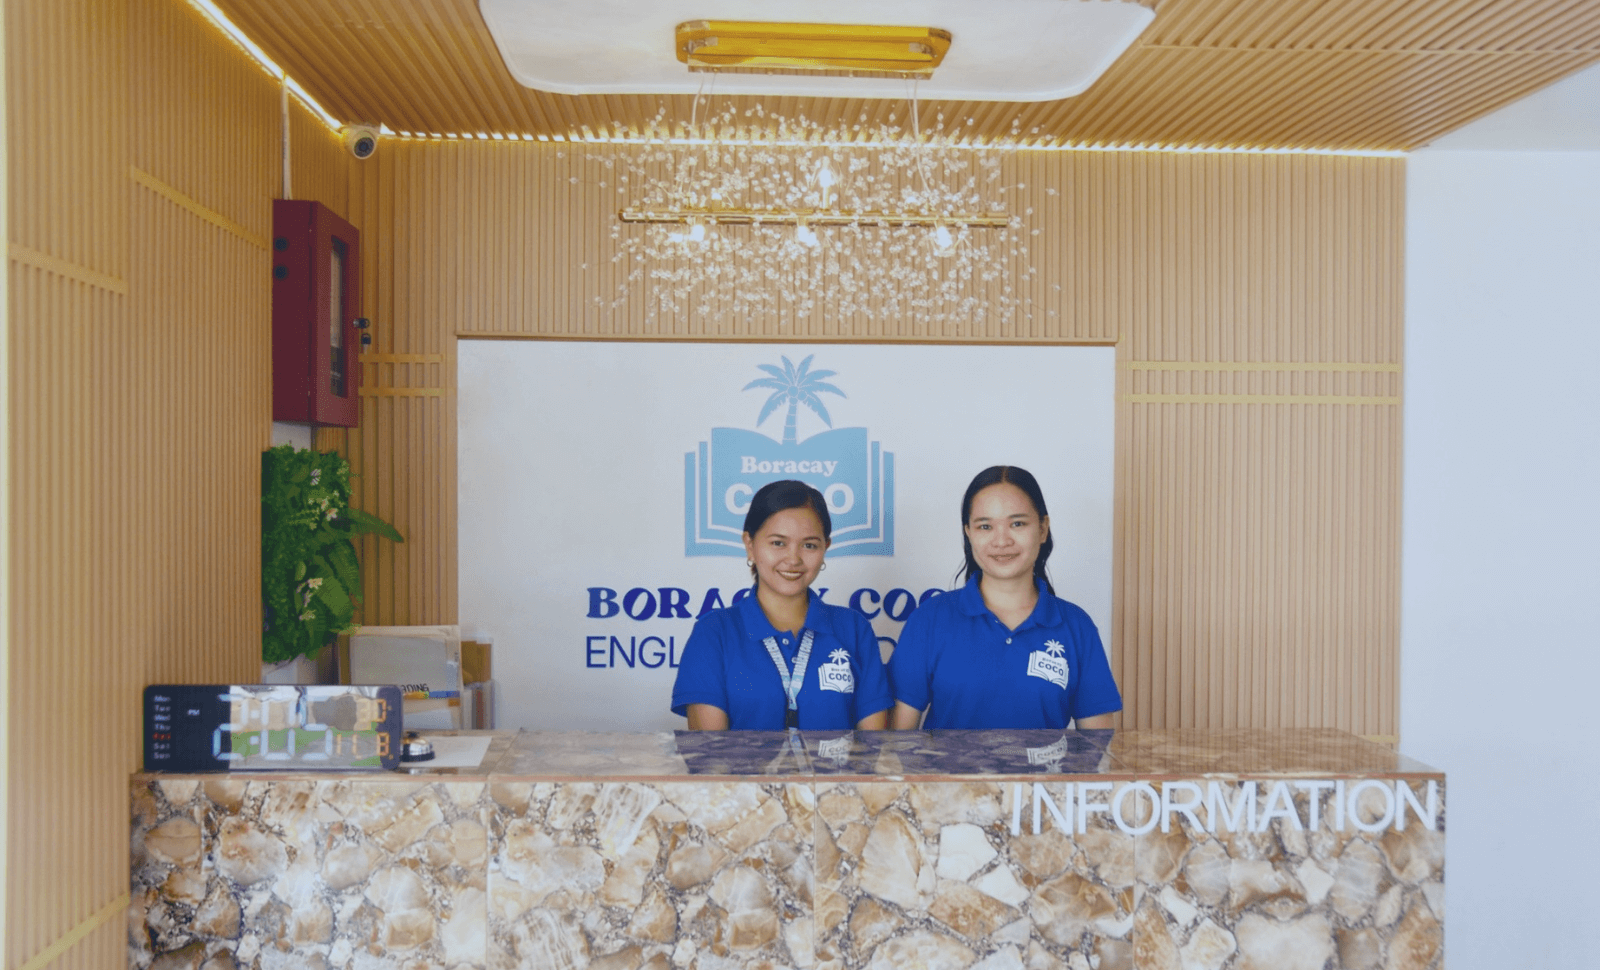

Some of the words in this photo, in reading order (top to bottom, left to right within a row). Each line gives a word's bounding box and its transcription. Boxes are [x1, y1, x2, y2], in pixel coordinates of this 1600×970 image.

[741, 456, 838, 477] Boracay
[725, 483, 854, 515] CO
[586, 587, 829, 621] BORA
[849, 588, 946, 622] CO
[586, 635, 680, 669] ENGL
[828, 672, 852, 682] COCO
[1038, 661, 1064, 677] COCO
[1011, 780, 1437, 836] INFORMATION
